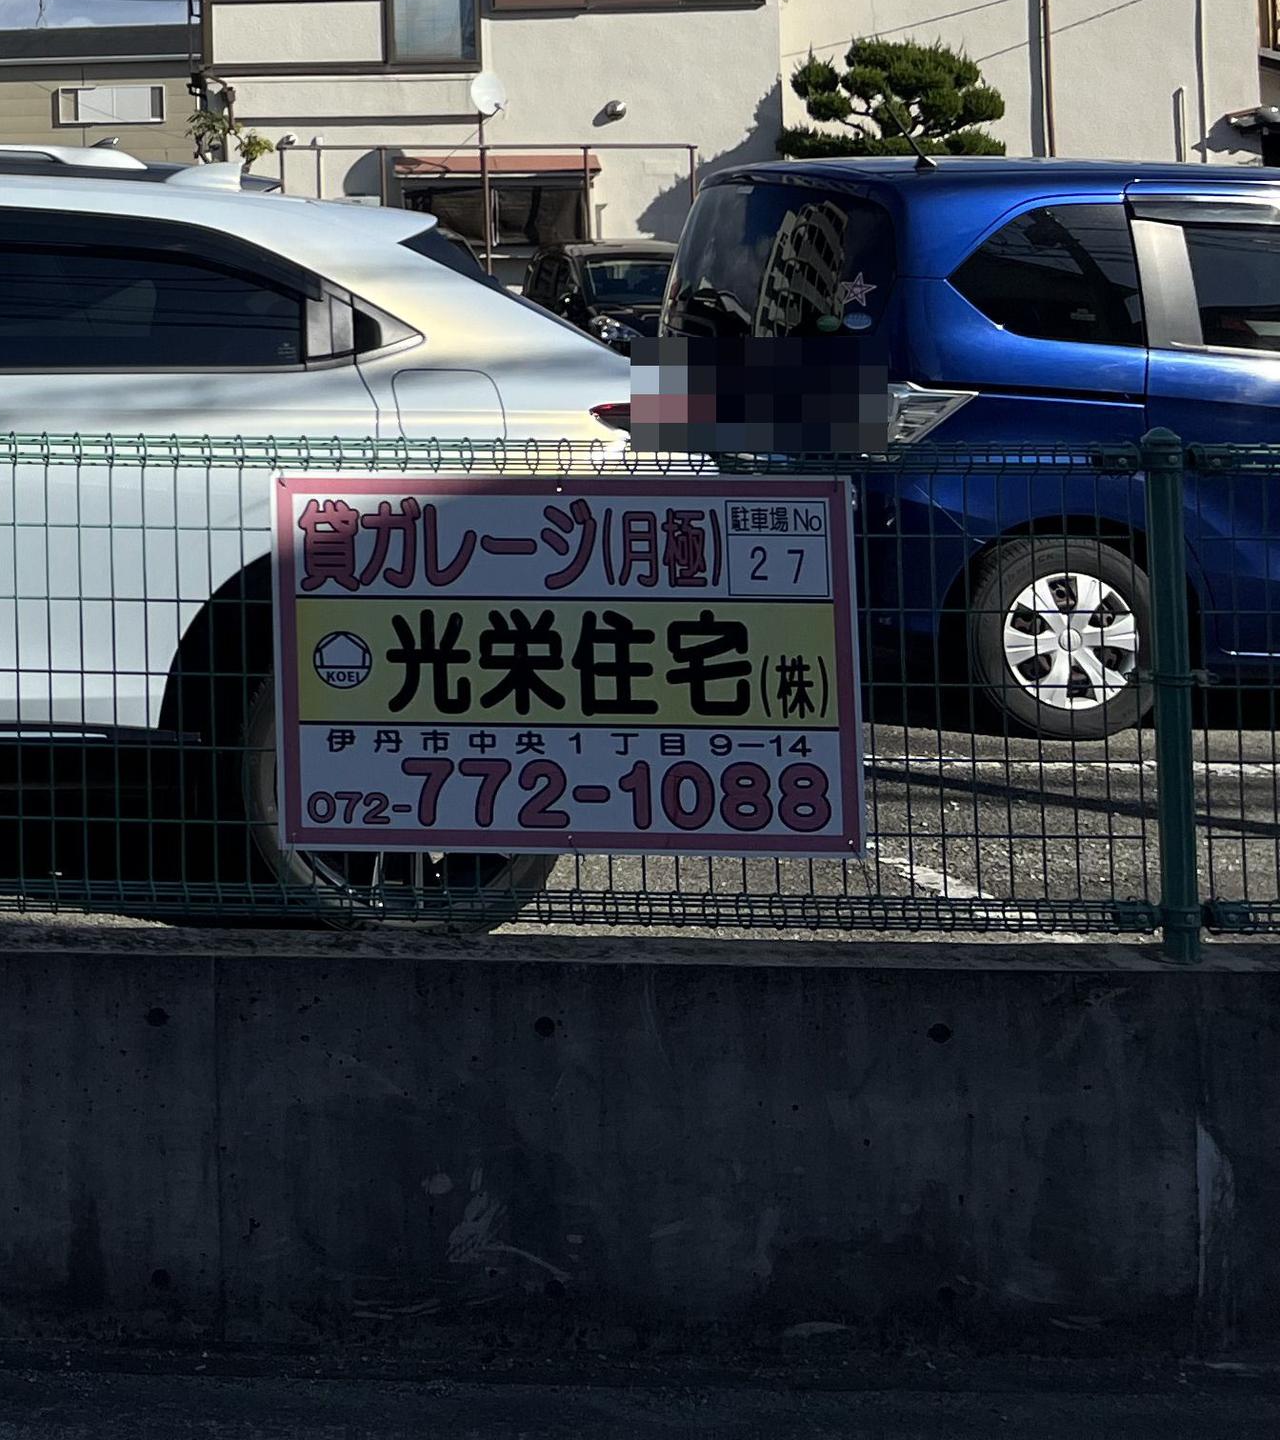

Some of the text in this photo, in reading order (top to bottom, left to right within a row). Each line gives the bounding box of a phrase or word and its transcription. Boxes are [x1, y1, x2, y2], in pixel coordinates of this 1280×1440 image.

[297, 497, 722, 592] 貸ガレージ(月極)
[326, 671, 361, 683] KOEI
[386, 608, 830, 720] 光栄住宅(株)
[307, 757, 833, 833] 072-772-1088
